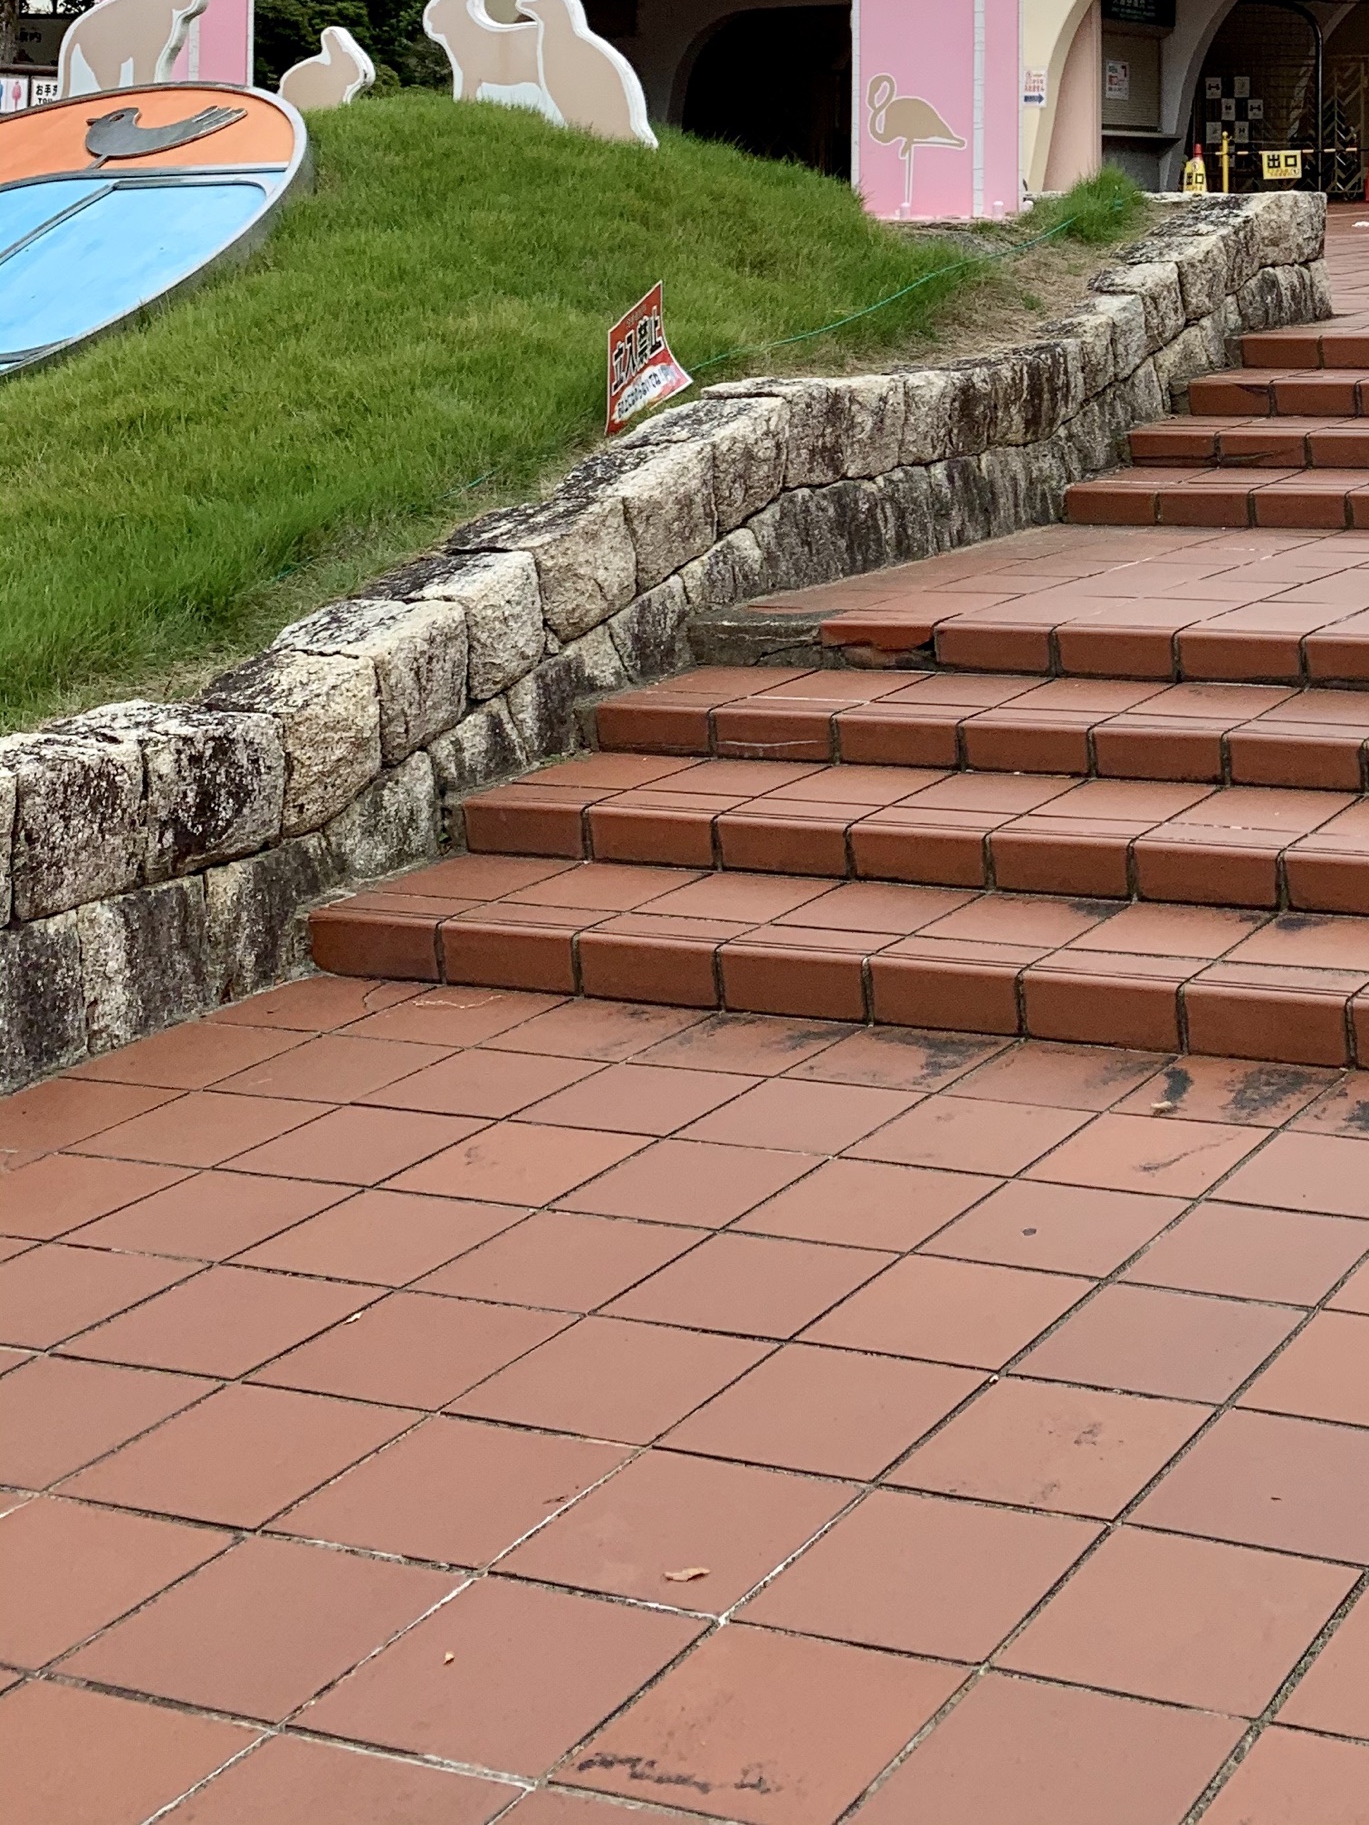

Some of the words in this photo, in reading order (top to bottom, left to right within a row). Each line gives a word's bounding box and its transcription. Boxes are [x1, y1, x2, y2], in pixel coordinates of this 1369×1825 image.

[1267, 154, 1298, 168] 出口
[611, 305, 665, 396] 立入禁止
